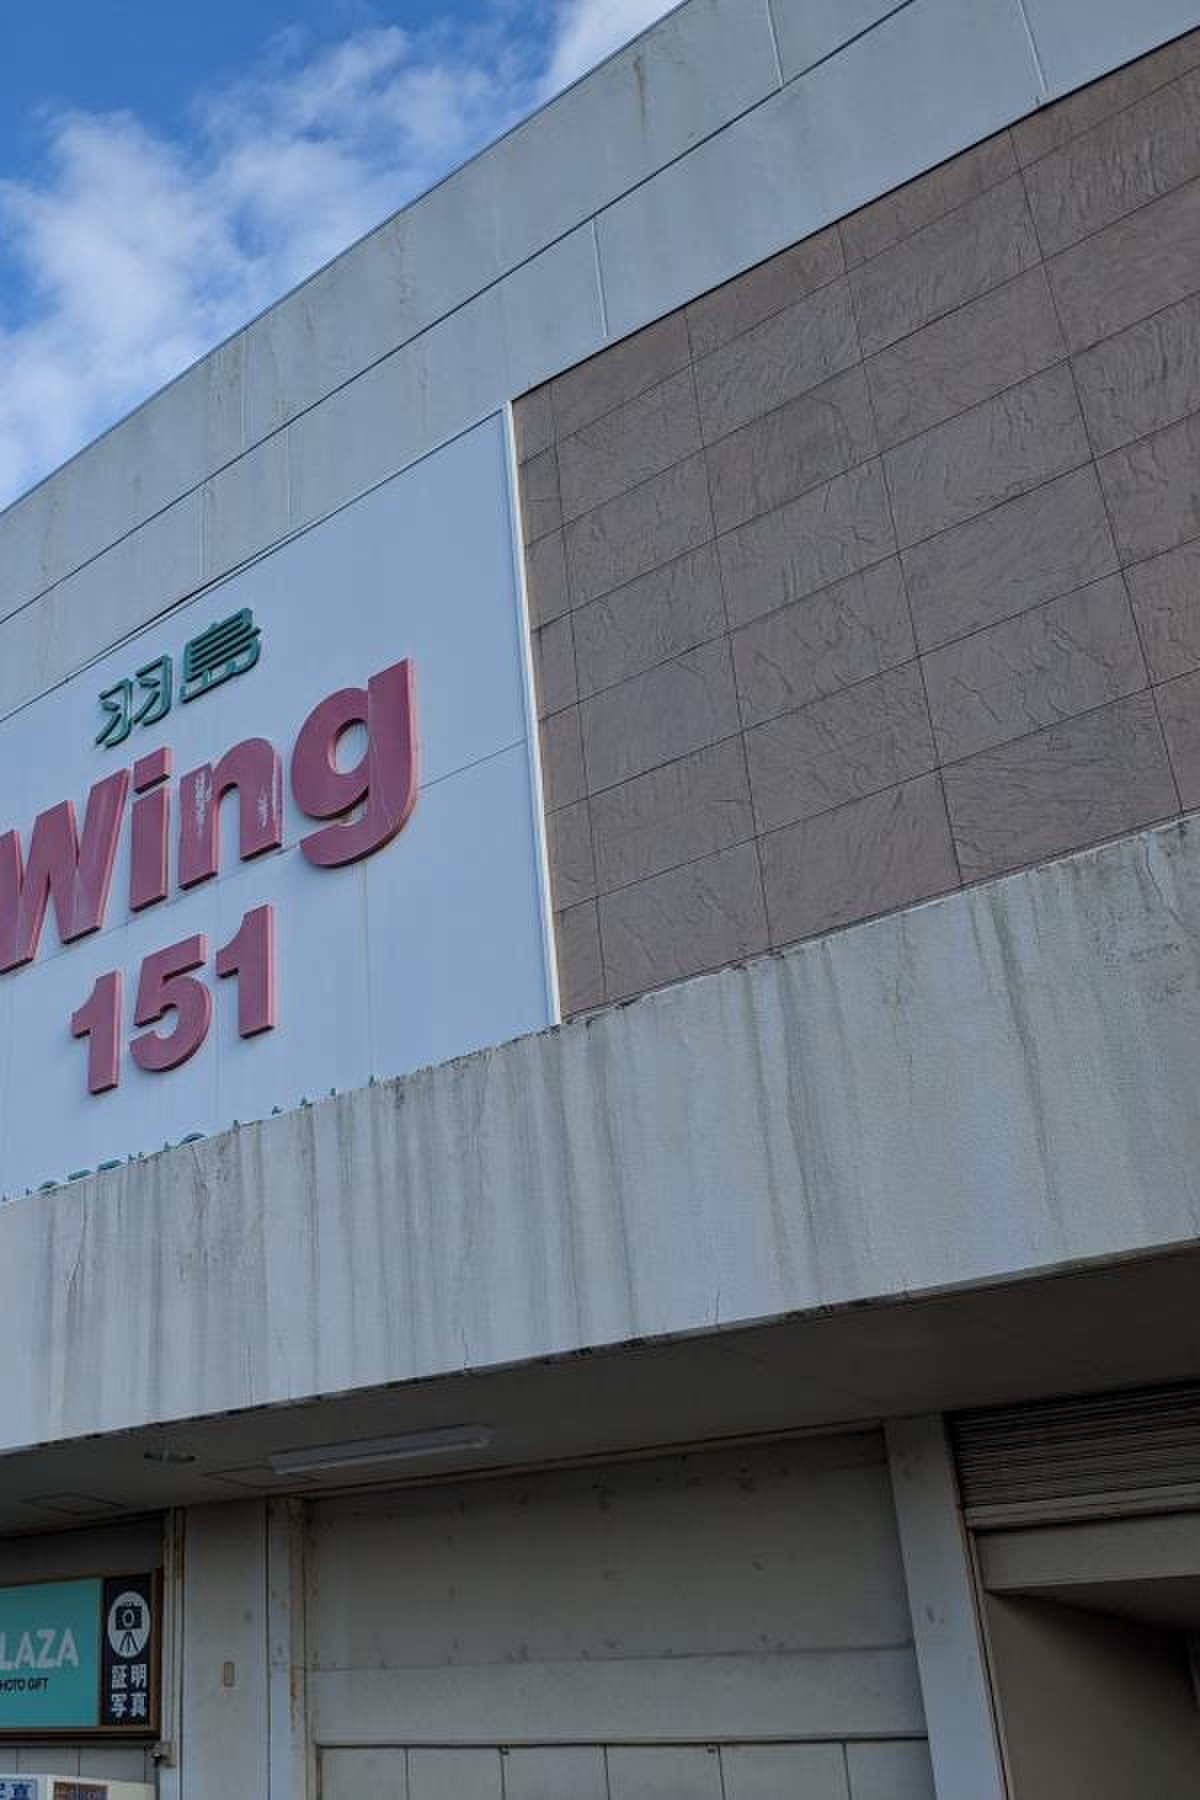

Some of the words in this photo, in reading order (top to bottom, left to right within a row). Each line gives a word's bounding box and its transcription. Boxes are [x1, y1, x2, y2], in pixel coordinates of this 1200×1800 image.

[95, 608, 262, 748] 羽島
[70, 904, 276, 1096] 151
[111, 1663, 147, 1690] 証明
[111, 1692, 147, 1718] 写真
